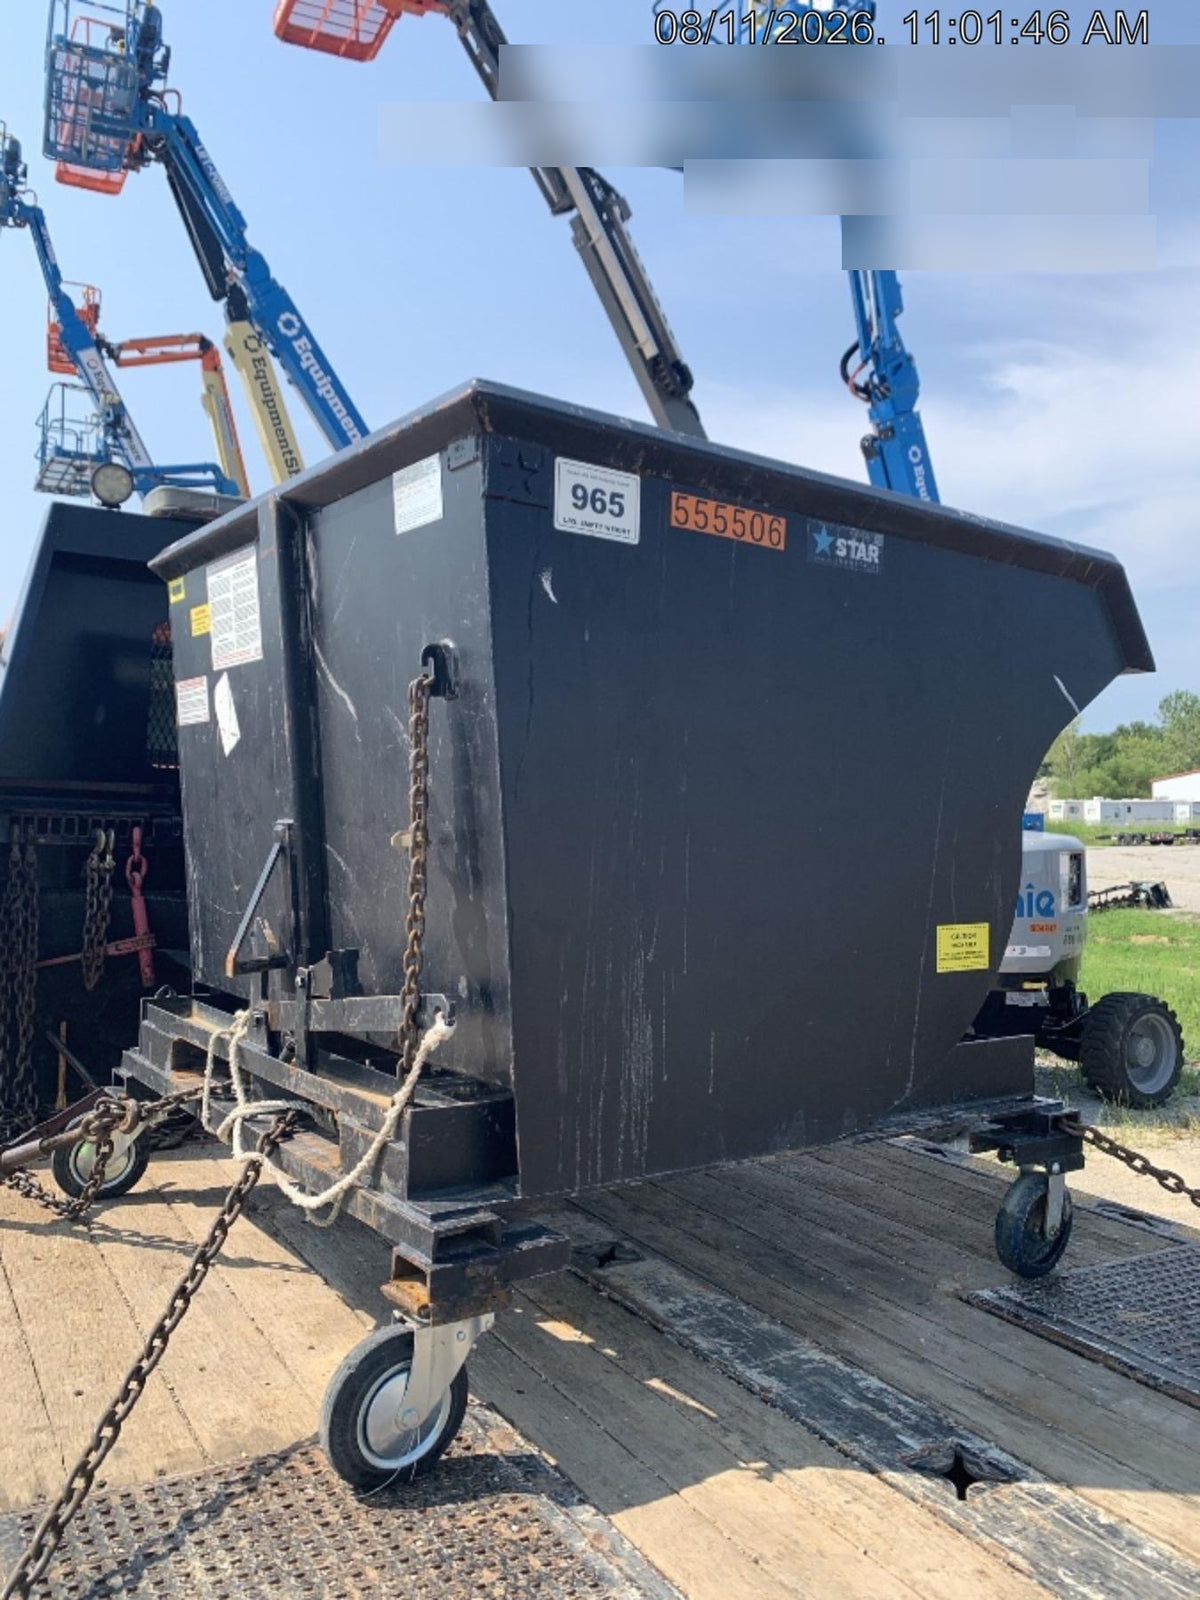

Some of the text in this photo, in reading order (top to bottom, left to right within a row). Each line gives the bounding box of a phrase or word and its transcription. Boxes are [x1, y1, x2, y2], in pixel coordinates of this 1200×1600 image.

[571, 484, 625, 518] 965
[674, 494, 782, 547] 555506
[835, 537, 880, 564] STAR
